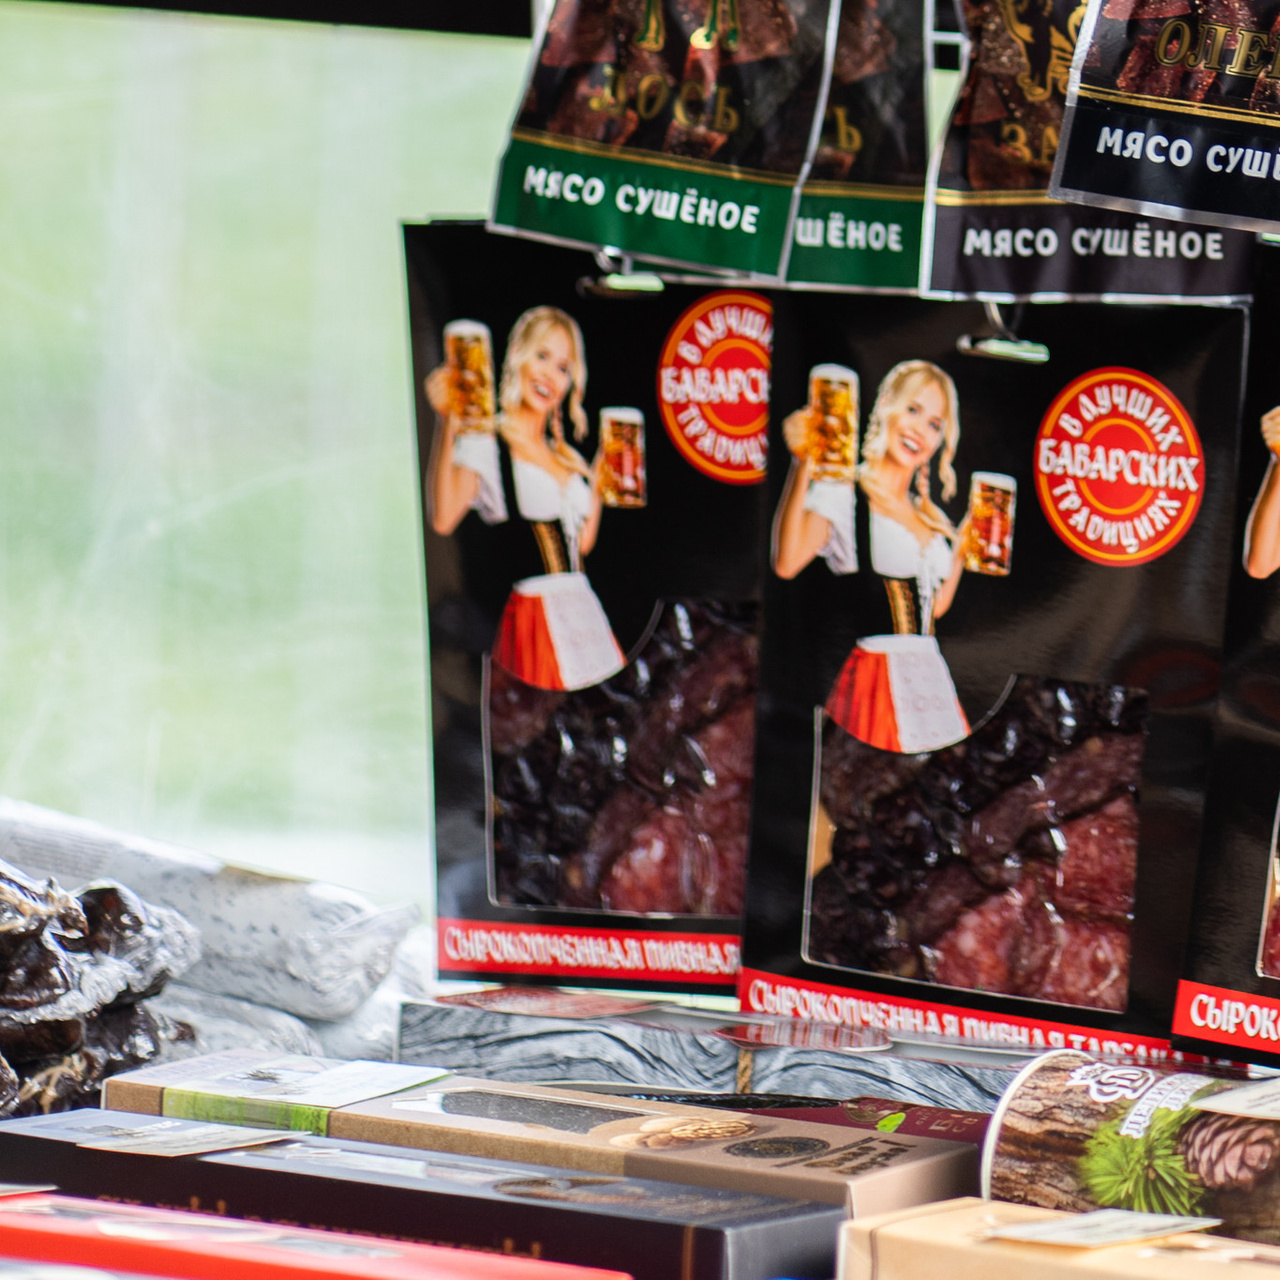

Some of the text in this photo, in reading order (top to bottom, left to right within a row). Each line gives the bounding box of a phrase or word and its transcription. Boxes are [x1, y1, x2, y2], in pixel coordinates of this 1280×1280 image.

[1097, 125, 1194, 168] МЯСО
[523, 165, 761, 235] МЯСО СУШЁНОЕ
[796, 211, 904, 252] ШЁНОЕ
[963, 221, 1225, 261] МЯСО СУШЁНОЕ
[693, 305, 774, 349] ЛУЧШ
[1058, 383, 1185, 453] В ЛУЧШИХ
[1038, 437, 1201, 493] БАВАРСКИХ
[1052, 477, 1182, 555] ТРАДИЦИЯХ
[445, 925, 646, 970] СЫРОКОПЧЕННАЯ
[749, 978, 960, 1038] СЫРОКОПЧЕННАЯ
